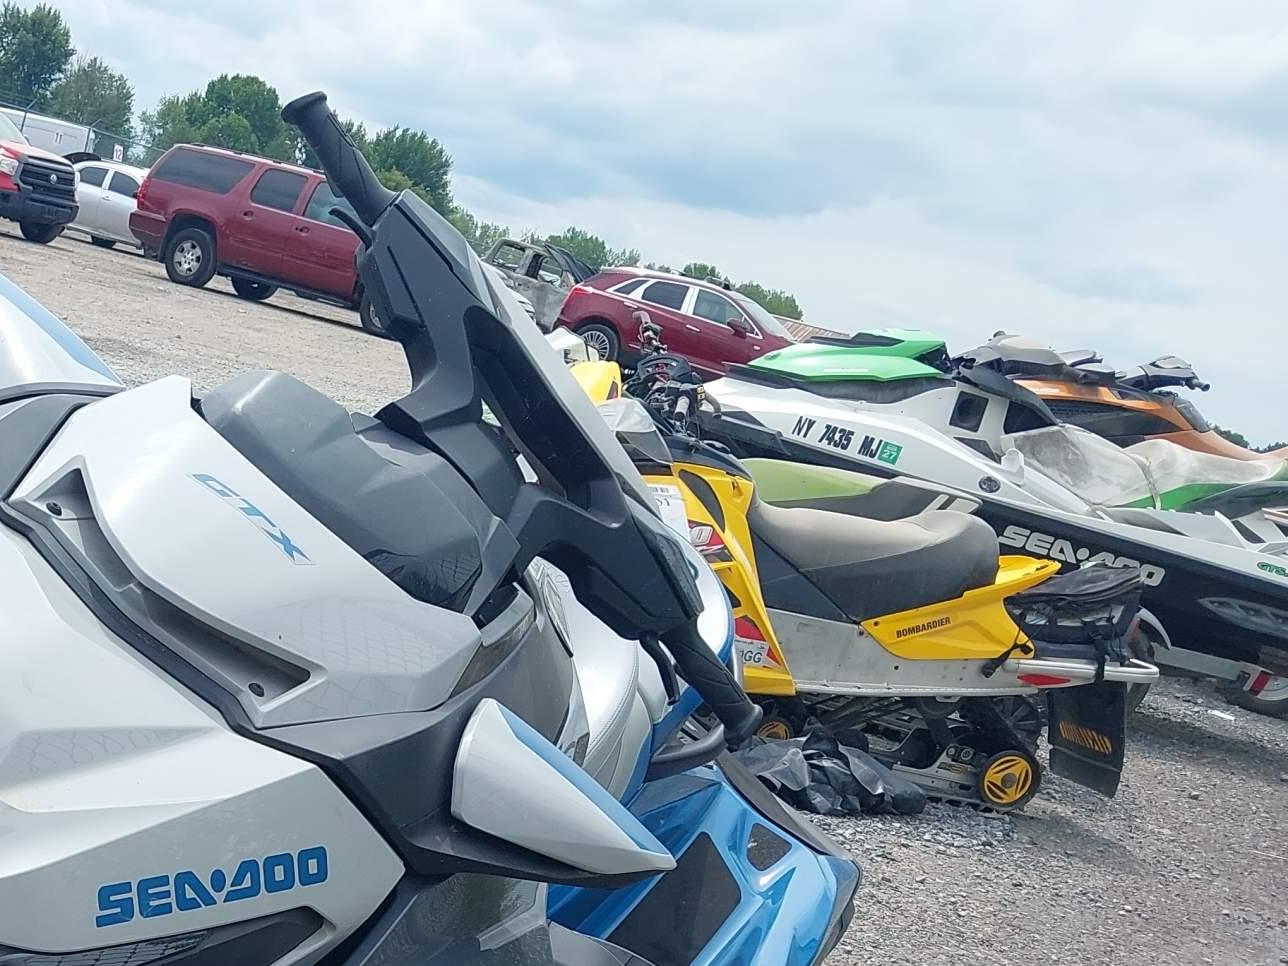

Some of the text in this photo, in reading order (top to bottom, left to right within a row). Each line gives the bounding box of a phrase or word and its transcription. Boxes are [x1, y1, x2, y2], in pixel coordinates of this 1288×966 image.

[792, 416, 883, 458] NY 7435 MJ
[882, 449, 897, 460] 27
[192, 474, 311, 562] GTX
[896, 616, 951, 638] BOMBARDIER
